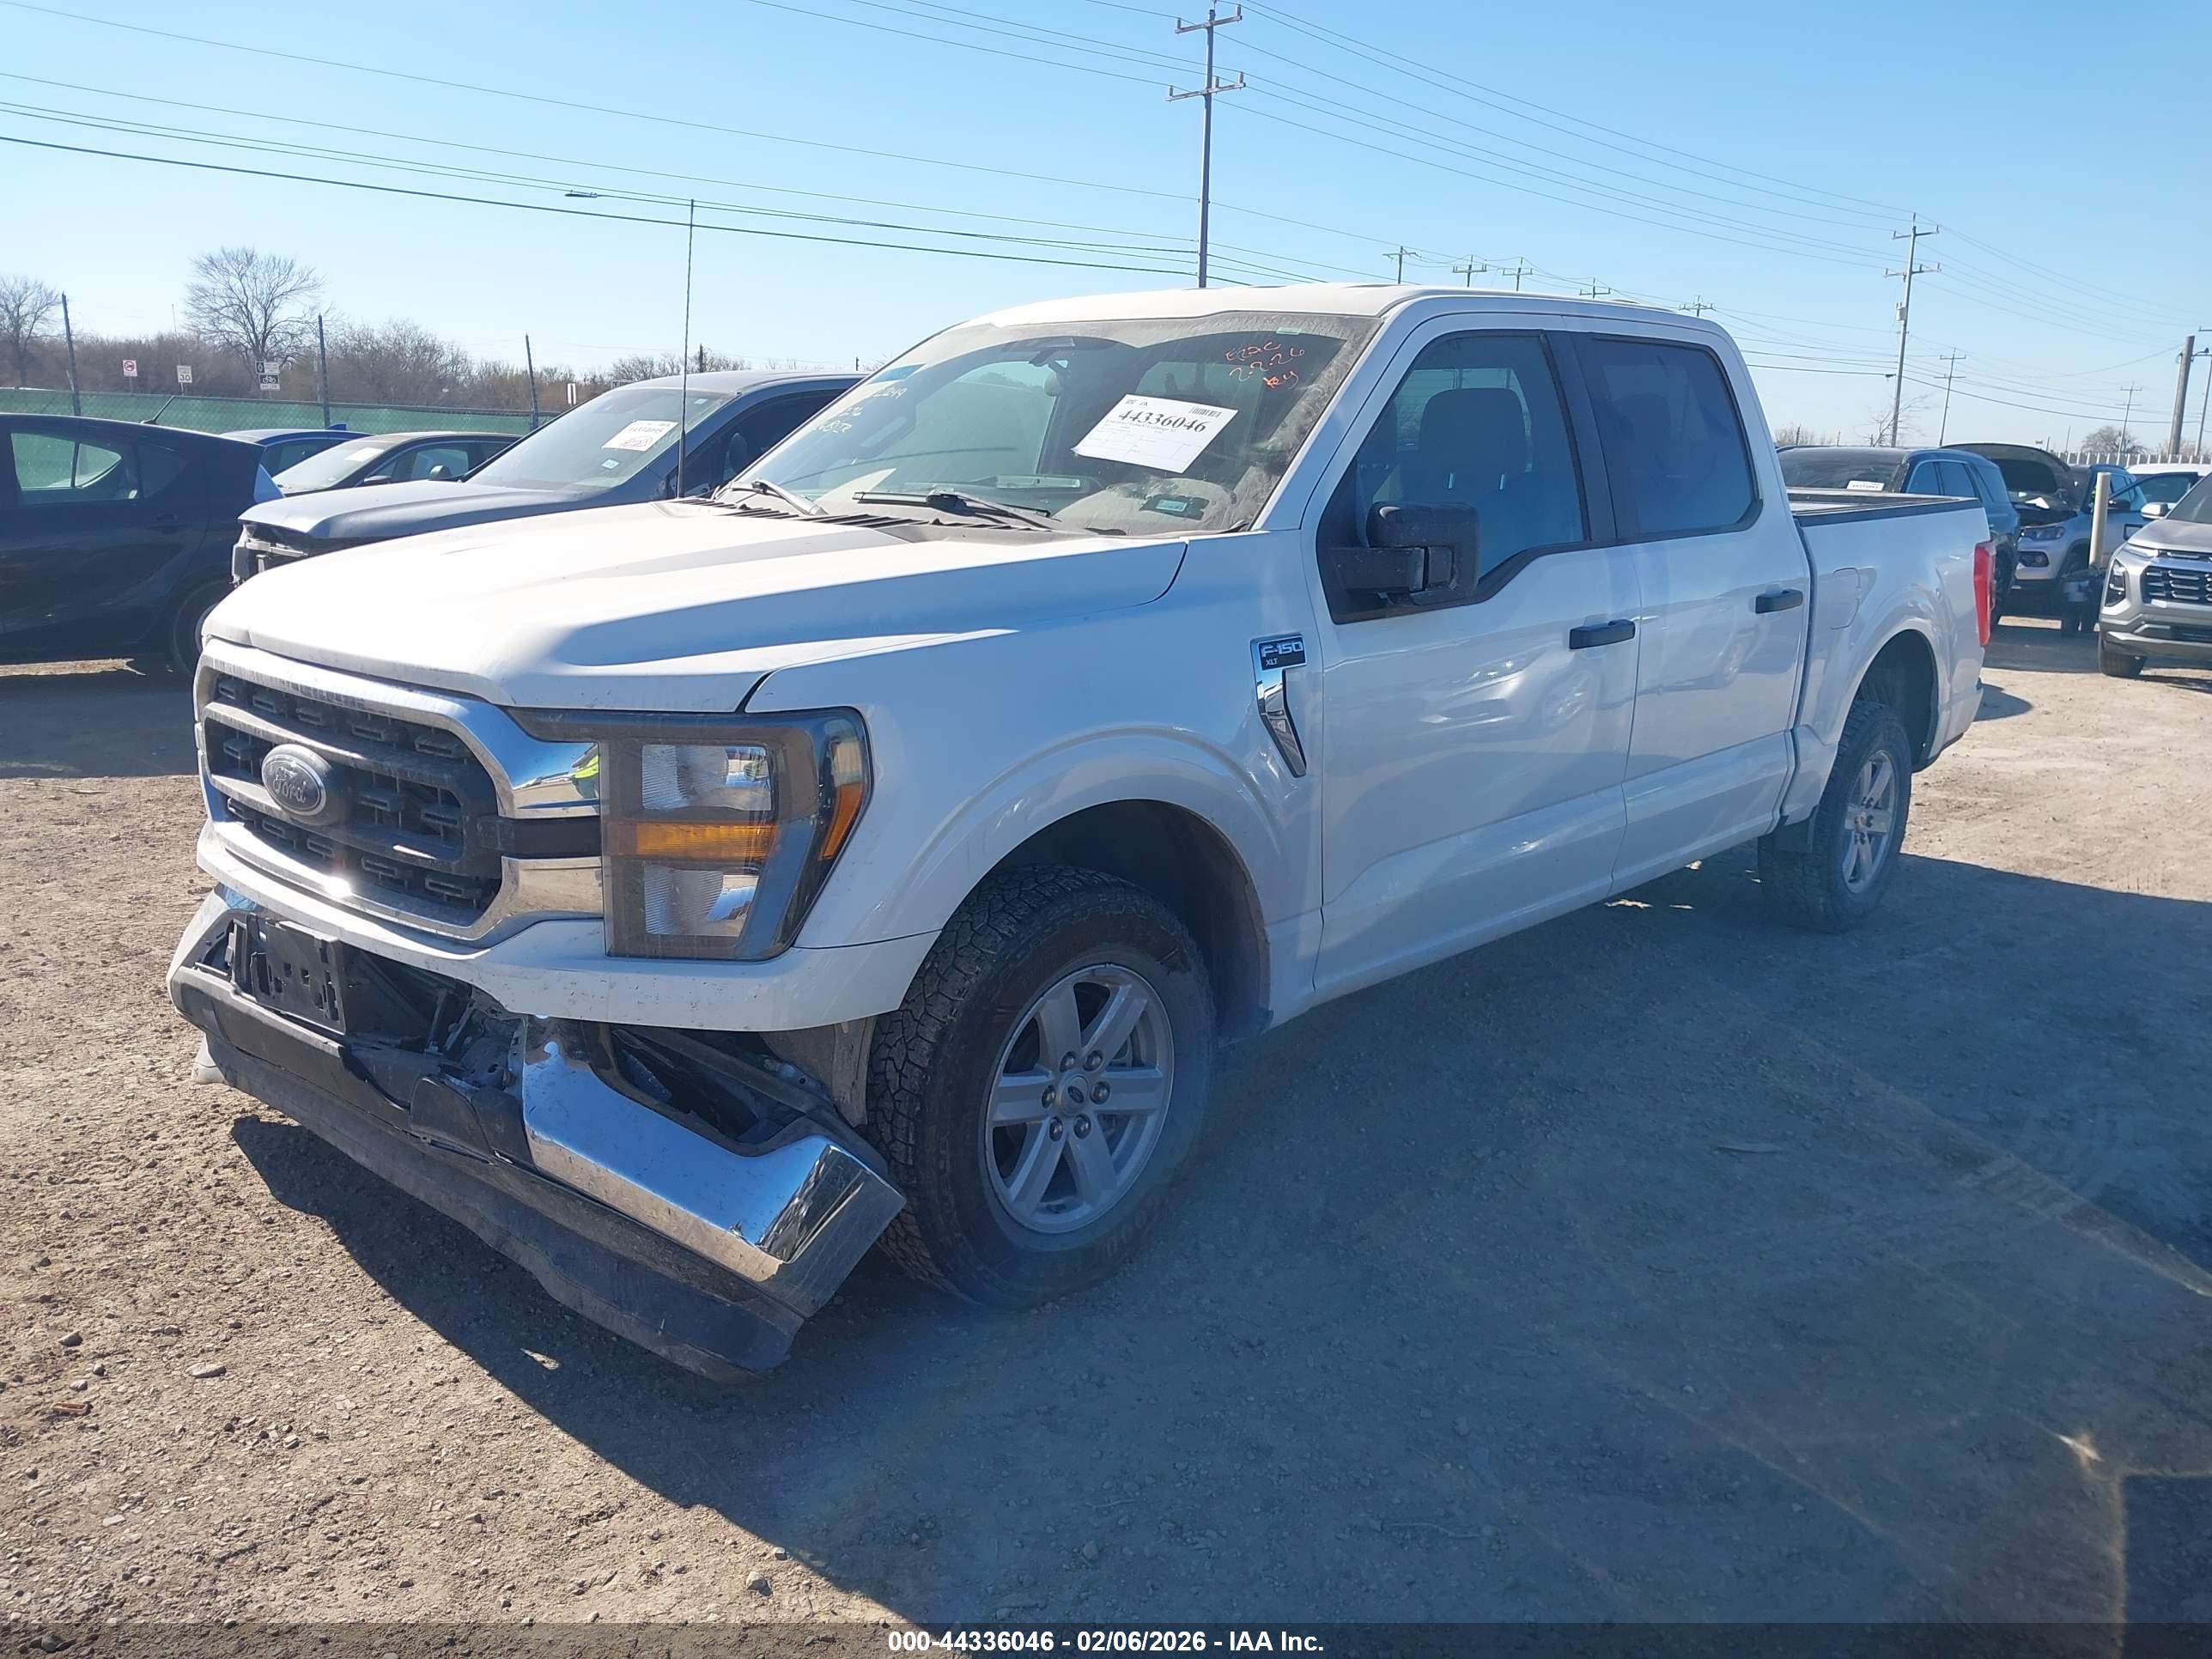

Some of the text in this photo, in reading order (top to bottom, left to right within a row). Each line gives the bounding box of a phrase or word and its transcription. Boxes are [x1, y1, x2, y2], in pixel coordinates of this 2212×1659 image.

[1118, 409, 1208, 433] 44336046
[1261, 641, 1304, 658] F-150
[1266, 658, 1279, 667] XLT
[272, 766, 307, 804] Ford
